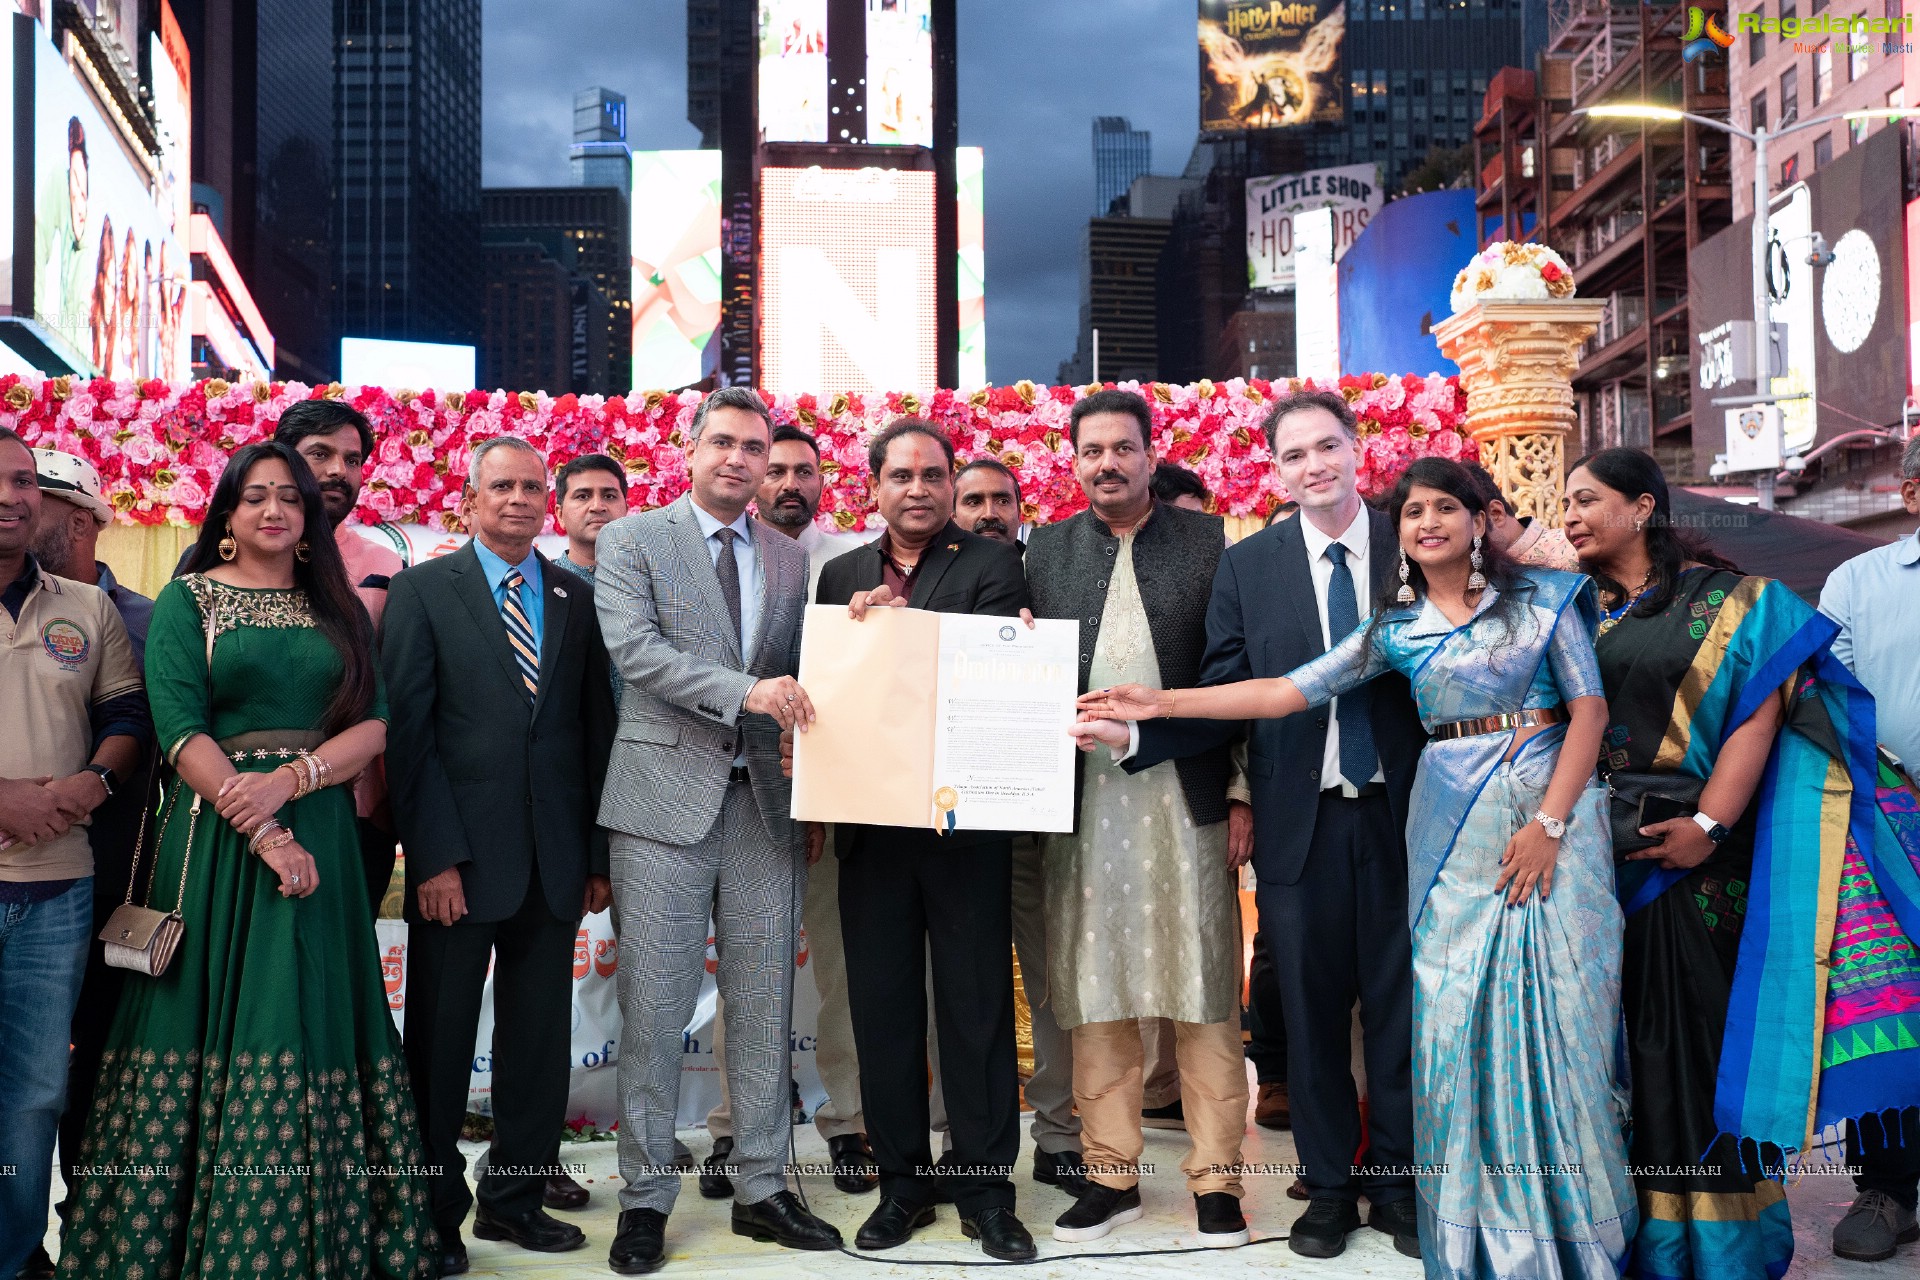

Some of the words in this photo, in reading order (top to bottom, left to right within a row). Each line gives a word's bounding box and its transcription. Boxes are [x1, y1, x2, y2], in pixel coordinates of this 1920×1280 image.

[1227, 6, 1270, 36] Harry
[1270, 1, 1318, 29] Potter
[1261, 175, 1321, 214] LITTLE
[1326, 175, 1372, 203] SHOP
[582, 1040, 615, 1069] of
